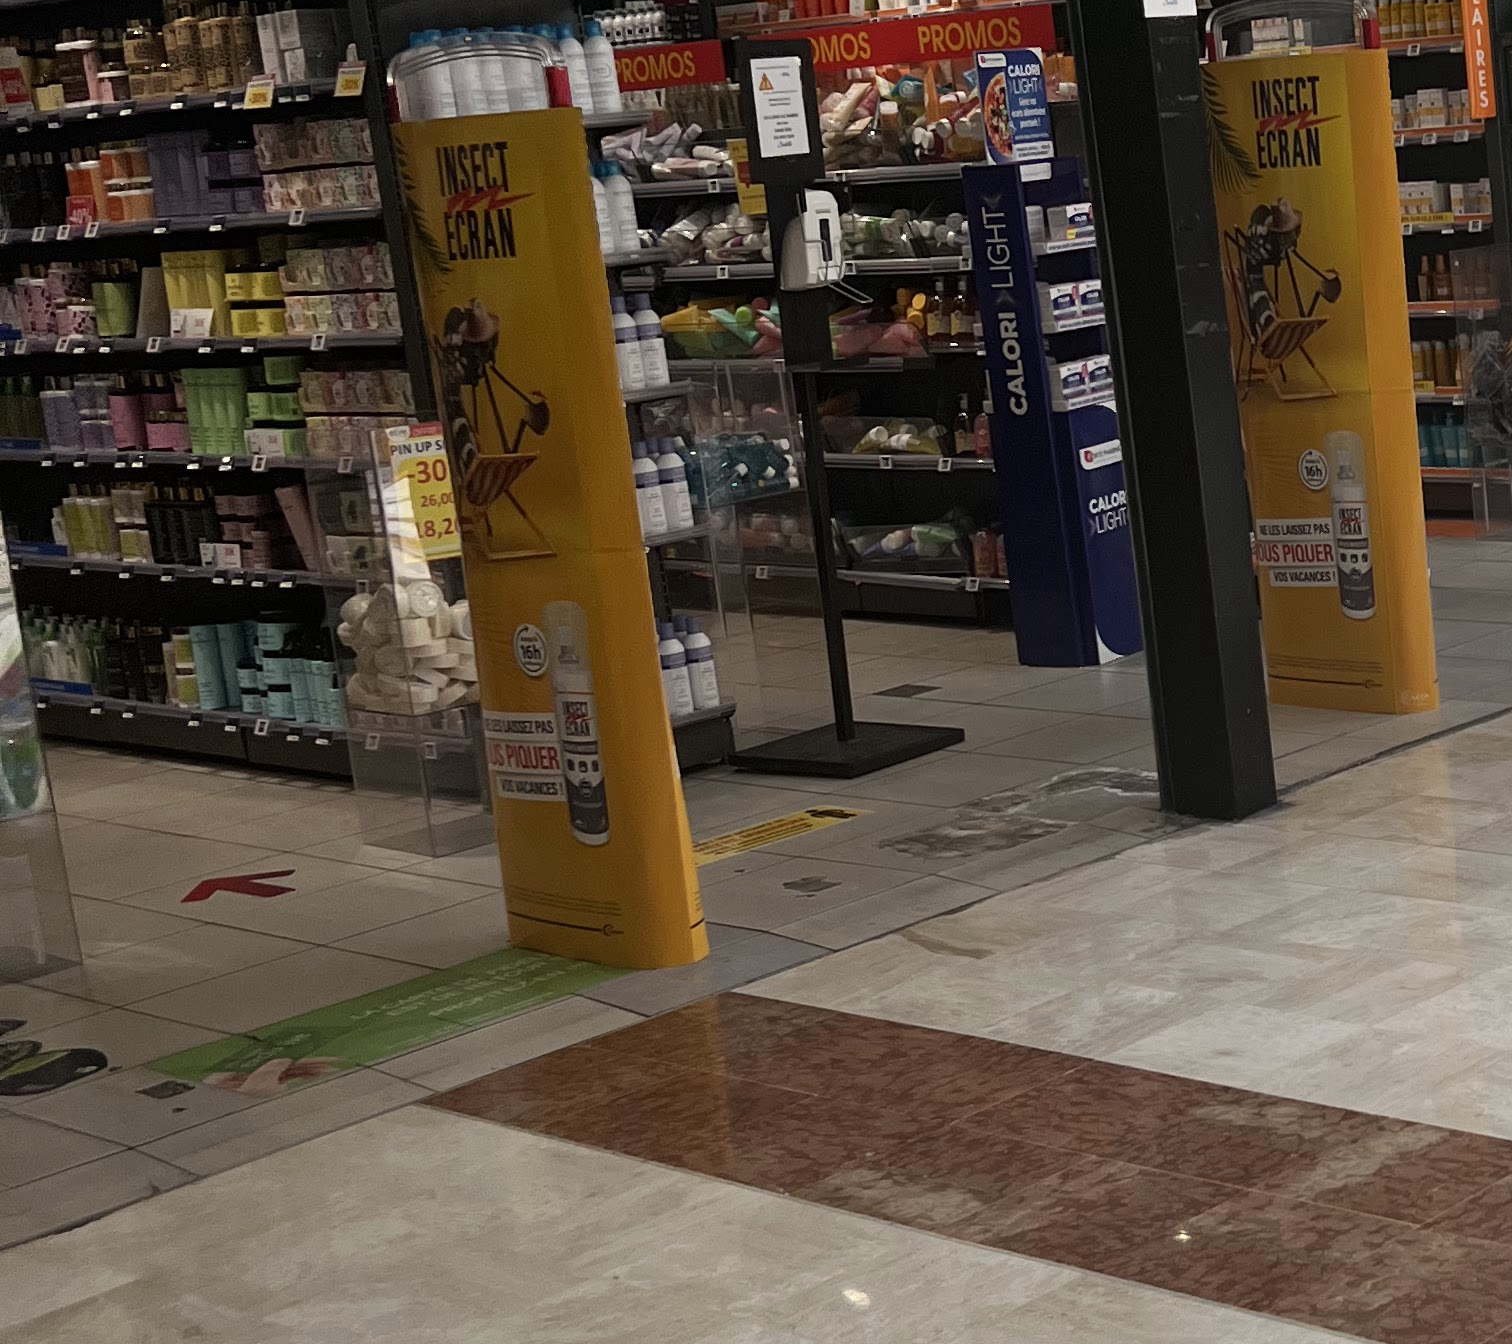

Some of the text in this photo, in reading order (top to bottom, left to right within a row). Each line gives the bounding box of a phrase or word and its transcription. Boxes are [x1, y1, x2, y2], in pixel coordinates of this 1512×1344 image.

[917, 17, 1022, 54] PROMOS
[1252, 76, 1320, 120] INSECT
[1256, 126, 1322, 170] ECRAN
[436, 141, 509, 198] INSECT
[444, 207, 517, 261] ECRAN
[981, 206, 1028, 416] CALORI LIGHT
[391, 443, 412, 456] PIN
[415, 442, 433, 453] UP
[1304, 465, 1323, 477] 16h
[1089, 489, 1127, 514] CALOR
[1095, 506, 1127, 534] LIGHT
[1282, 524, 1312, 536] LAISSEZ
[1313, 523, 1330, 535] PAS
[1254, 543, 1334, 564] OUS PIQUER
[1289, 570, 1331, 583] VACANCES
[519, 644, 542, 660] 16h
[535, 720, 554, 735] PAS
[506, 743, 560, 770] PIQUER
